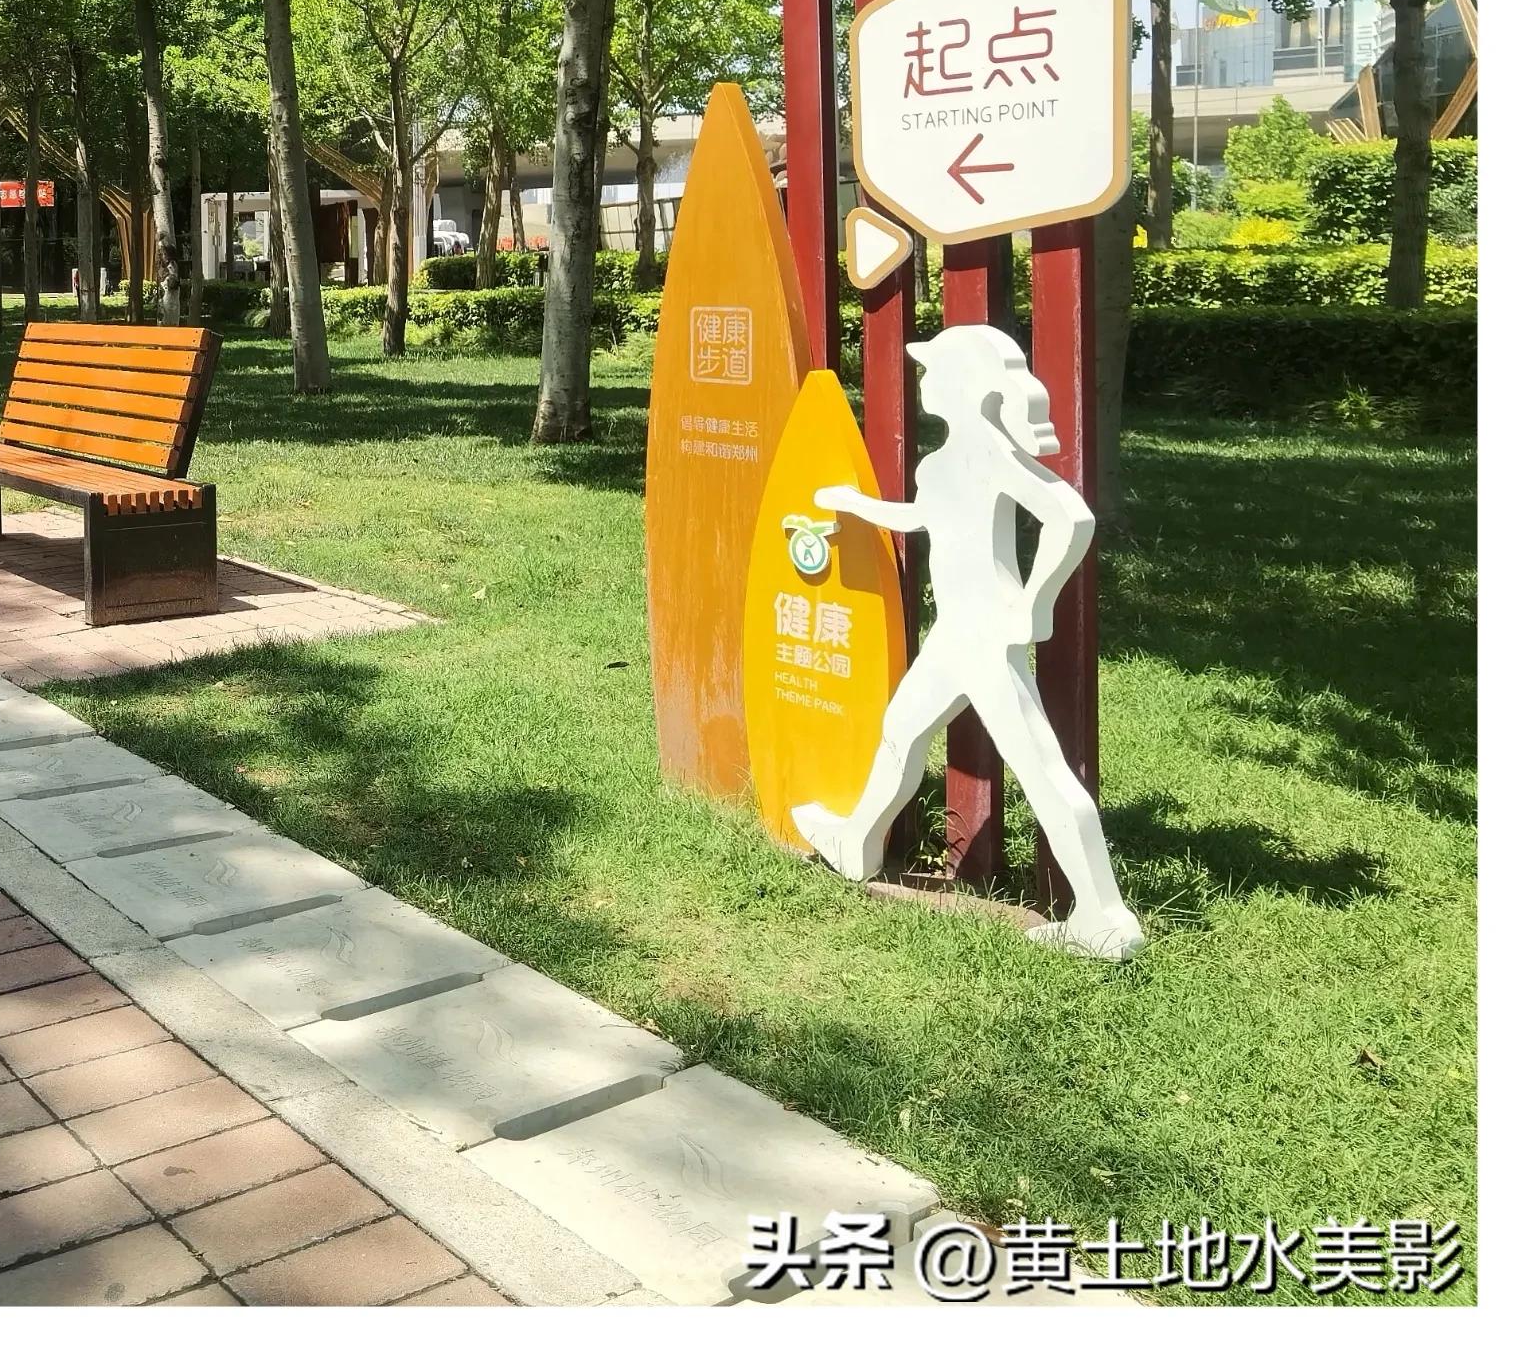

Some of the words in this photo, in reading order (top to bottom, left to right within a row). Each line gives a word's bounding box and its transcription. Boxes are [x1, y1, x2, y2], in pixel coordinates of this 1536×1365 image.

[904, 6, 1060, 98] 起点
[901, 106, 992, 131] STARTING
[998, 99, 1059, 122] POINT
[696, 314, 748, 345] 健康
[696, 346, 748, 378] 步道
[680, 415, 759, 438] 倡导健康生活
[773, 591, 853, 649] 健康
[775, 643, 852, 679] 主题公园
[775, 671, 818, 690] HEALTH
[775, 687, 813, 708] THEME
[814, 698, 844, 716] PARK
